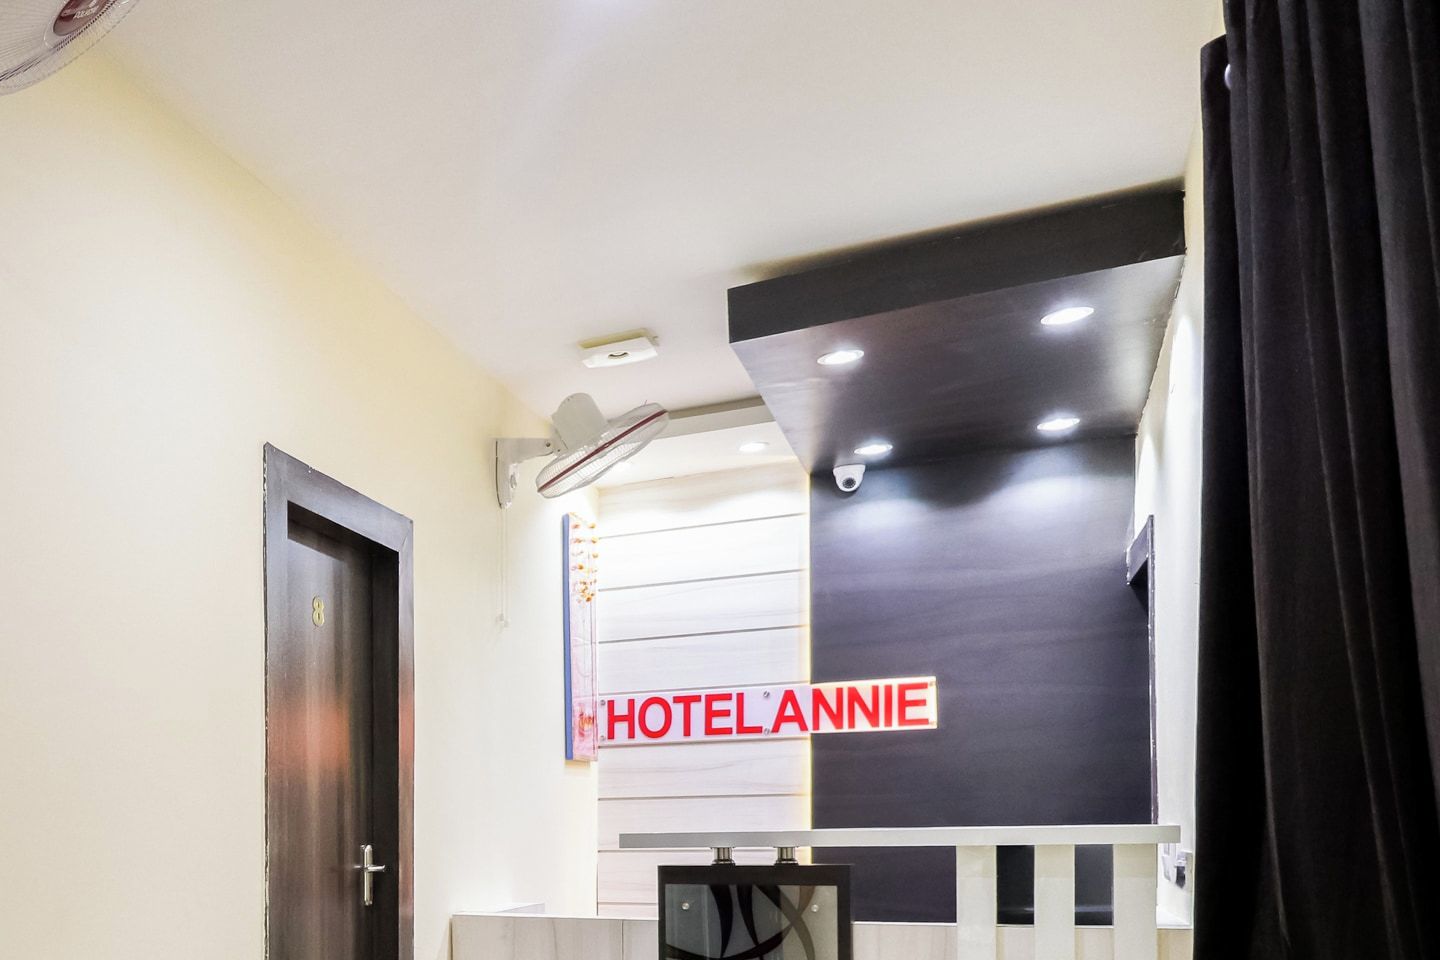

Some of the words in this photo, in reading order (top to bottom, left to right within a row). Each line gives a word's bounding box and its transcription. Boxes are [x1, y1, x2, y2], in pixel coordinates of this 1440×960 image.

[311, 596, 325, 627] 8
[607, 692, 764, 741] HOTEL
[771, 682, 930, 734] ANNIE
